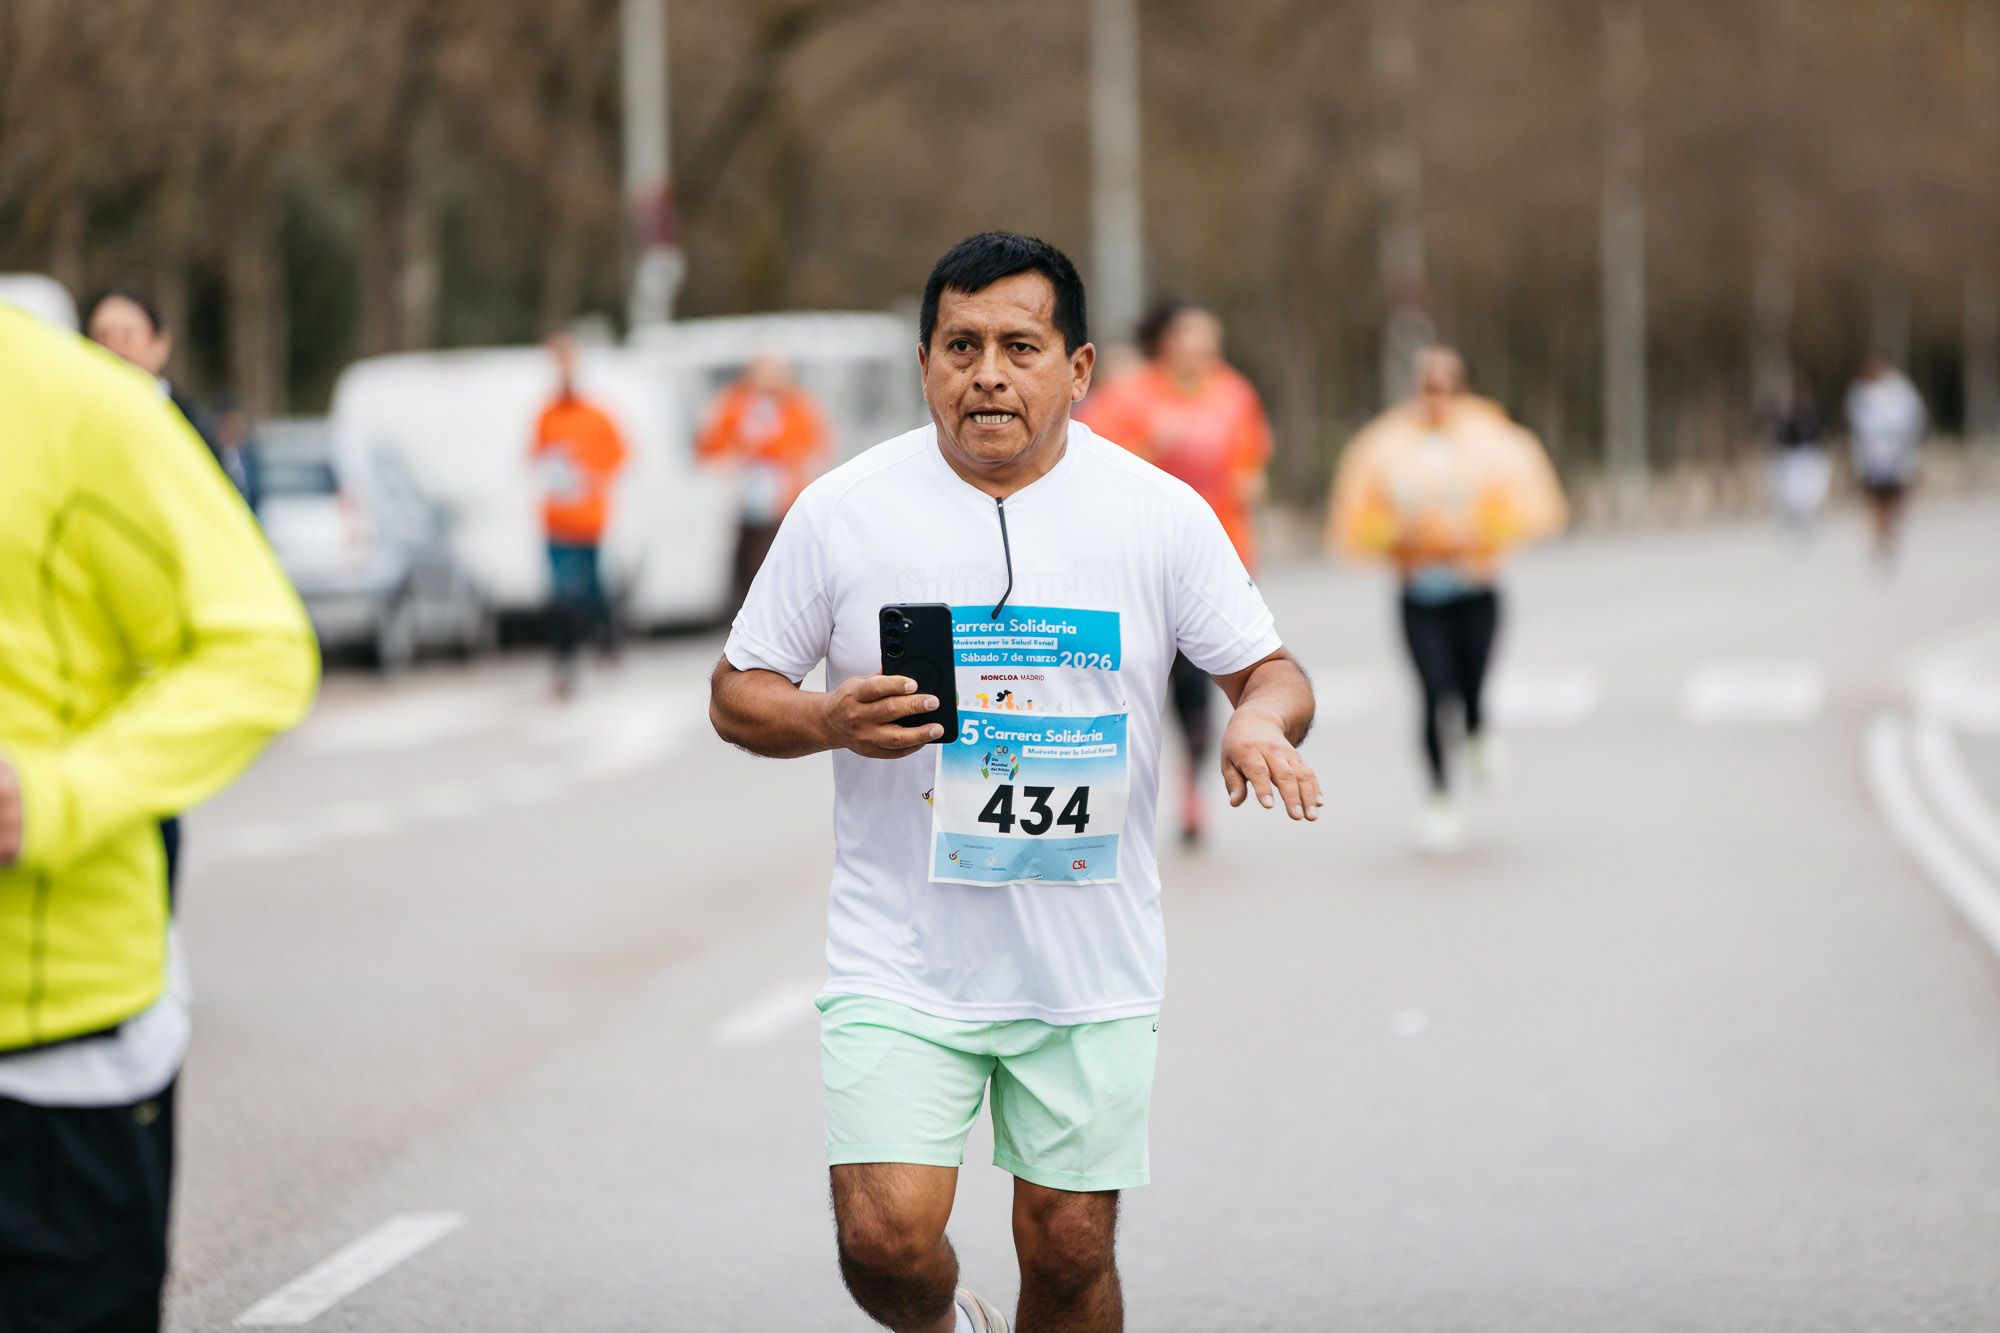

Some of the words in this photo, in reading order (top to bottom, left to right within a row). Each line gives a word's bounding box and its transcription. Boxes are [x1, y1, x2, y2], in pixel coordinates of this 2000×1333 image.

[952, 620, 1004, 633] arrera
[1010, 619, 1077, 635] Solidaria
[1011, 638, 1031, 646] Salud
[1034, 639, 1054, 647] Renal
[961, 652, 999, 663] Sábado
[1002, 653, 1009, 662] 7
[1011, 652, 1024, 662] de
[1026, 654, 1057, 663] marzo
[1059, 651, 1113, 671] 2026
[1020, 674, 1045, 682] MADRID
[984, 726, 1041, 742] Carrera
[1045, 729, 1103, 744] Solidaria
[978, 784, 1090, 836] 434
[1072, 859, 1087, 871] CSL
